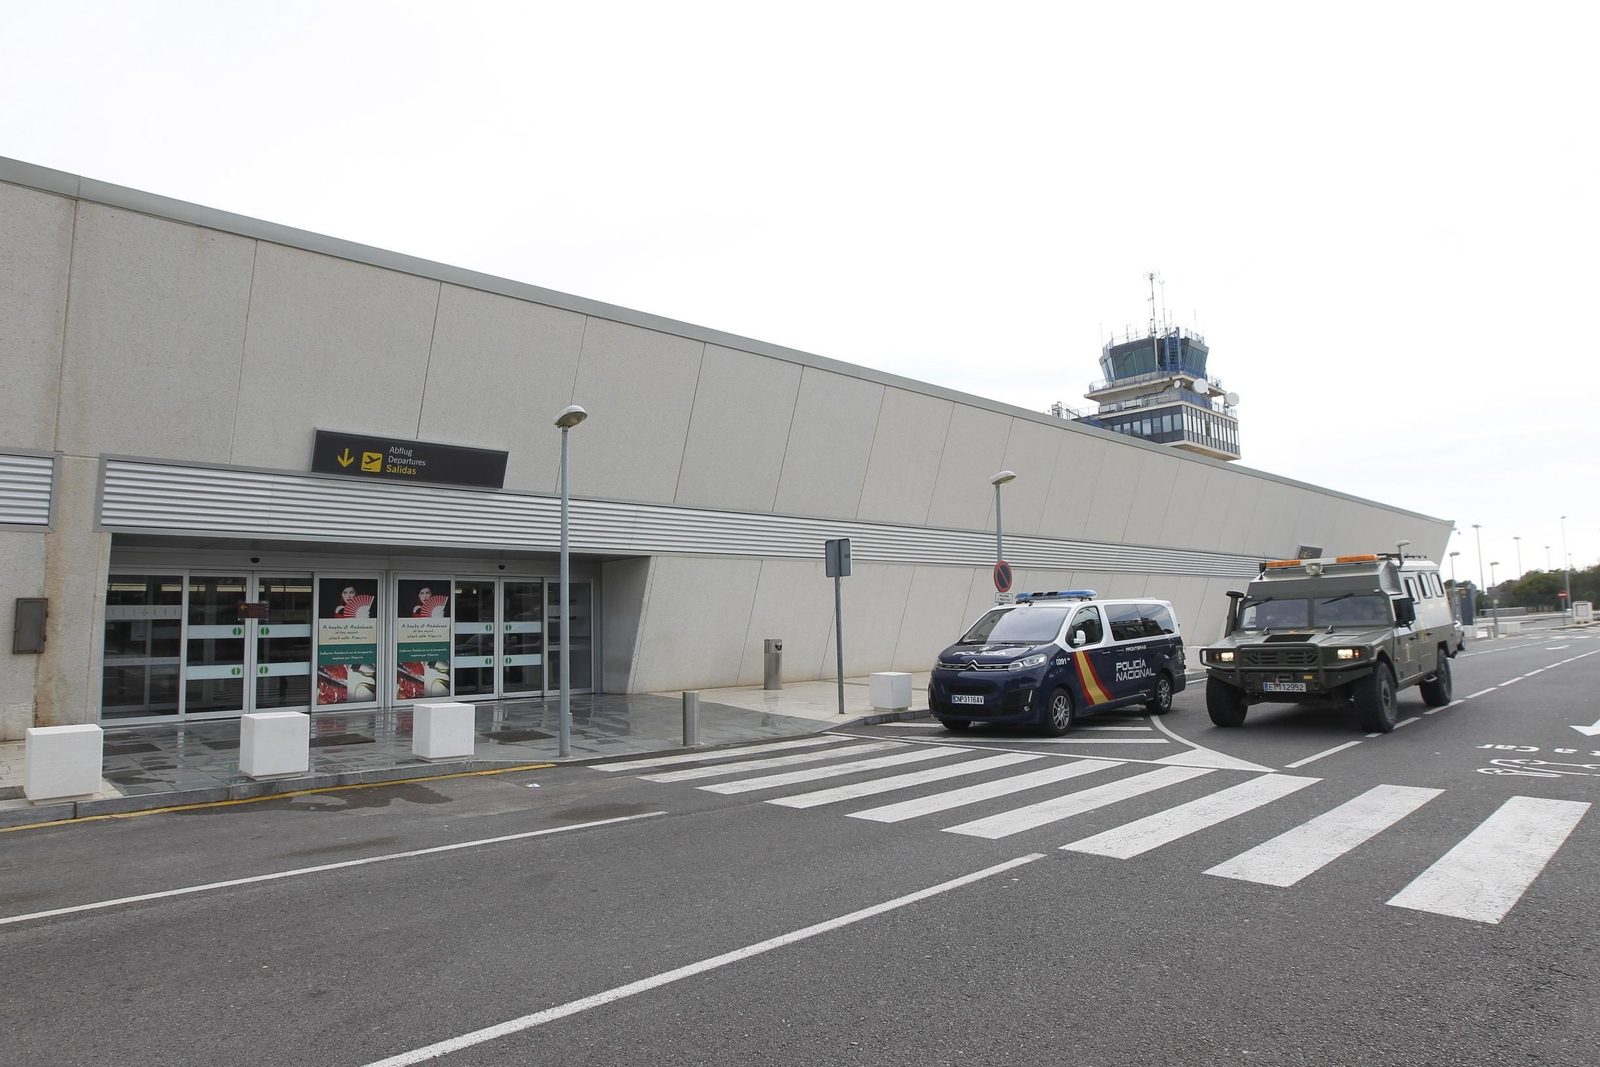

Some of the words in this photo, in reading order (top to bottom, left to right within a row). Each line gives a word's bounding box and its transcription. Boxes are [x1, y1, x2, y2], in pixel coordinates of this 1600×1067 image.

[389, 446, 413, 457] Abflug
[388, 455, 426, 467] Departures
[386, 464, 417, 475] Salidas
[1115, 657, 1147, 672] POLICÍA
[1115, 667, 1156, 682] NACIONAL
[1476, 744, 1540, 752] Car
